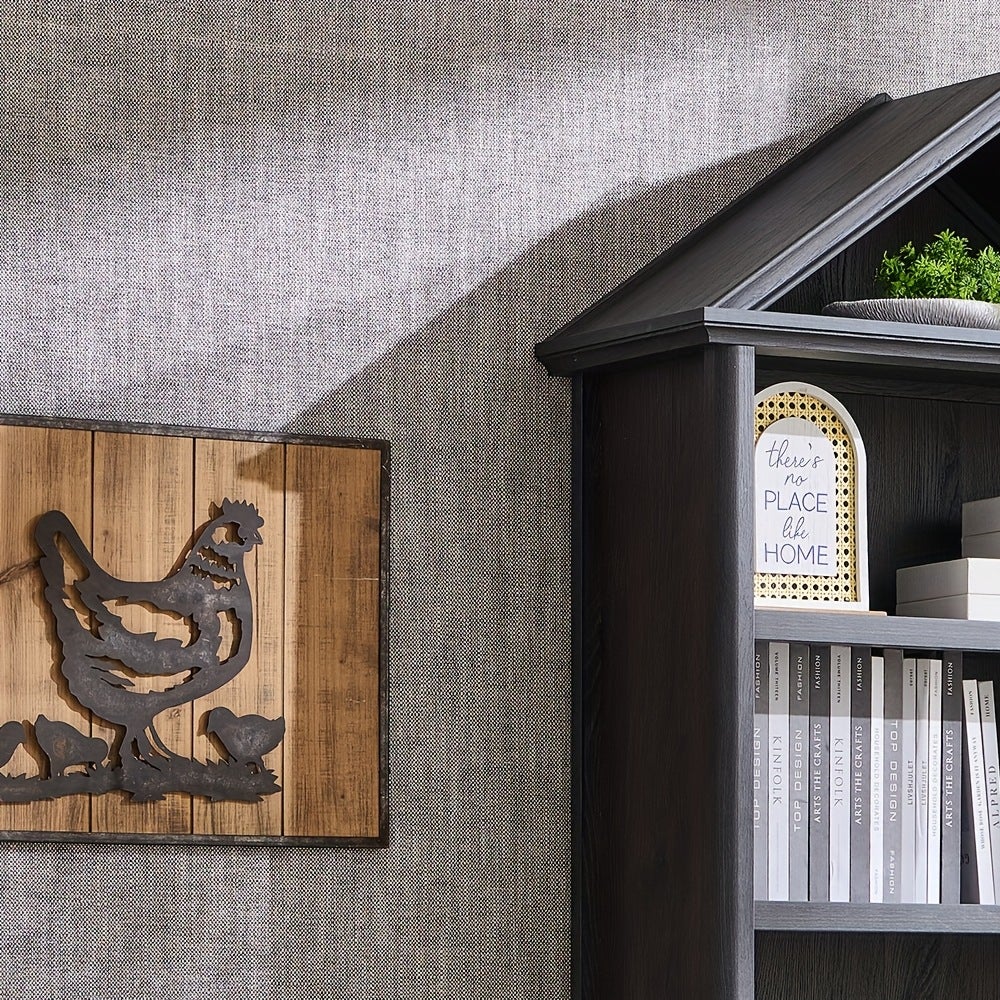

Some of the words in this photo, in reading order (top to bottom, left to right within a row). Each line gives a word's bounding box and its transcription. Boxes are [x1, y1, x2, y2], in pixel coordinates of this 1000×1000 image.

[765, 439, 824, 468] there's
[784, 473, 808, 487] no
[764, 490, 828, 513] PLACE
[782, 516, 809, 540] like
[764, 543, 829, 566] HOME
[890, 720, 898, 752] TOP
[945, 729, 953, 771] CRAFTS
[772, 736, 782, 805] KINFOLK
[794, 729, 802, 791] DESIGN
[834, 738, 844, 807] KINFOLK
[889, 761, 898, 823] DESIGN
[945, 774, 953, 796] THE
[988, 765, 1000, 829] ALPRED
[793, 799, 801, 832] TOP
[854, 797, 862, 825] ARTS
[945, 800, 953, 827] ARTS
